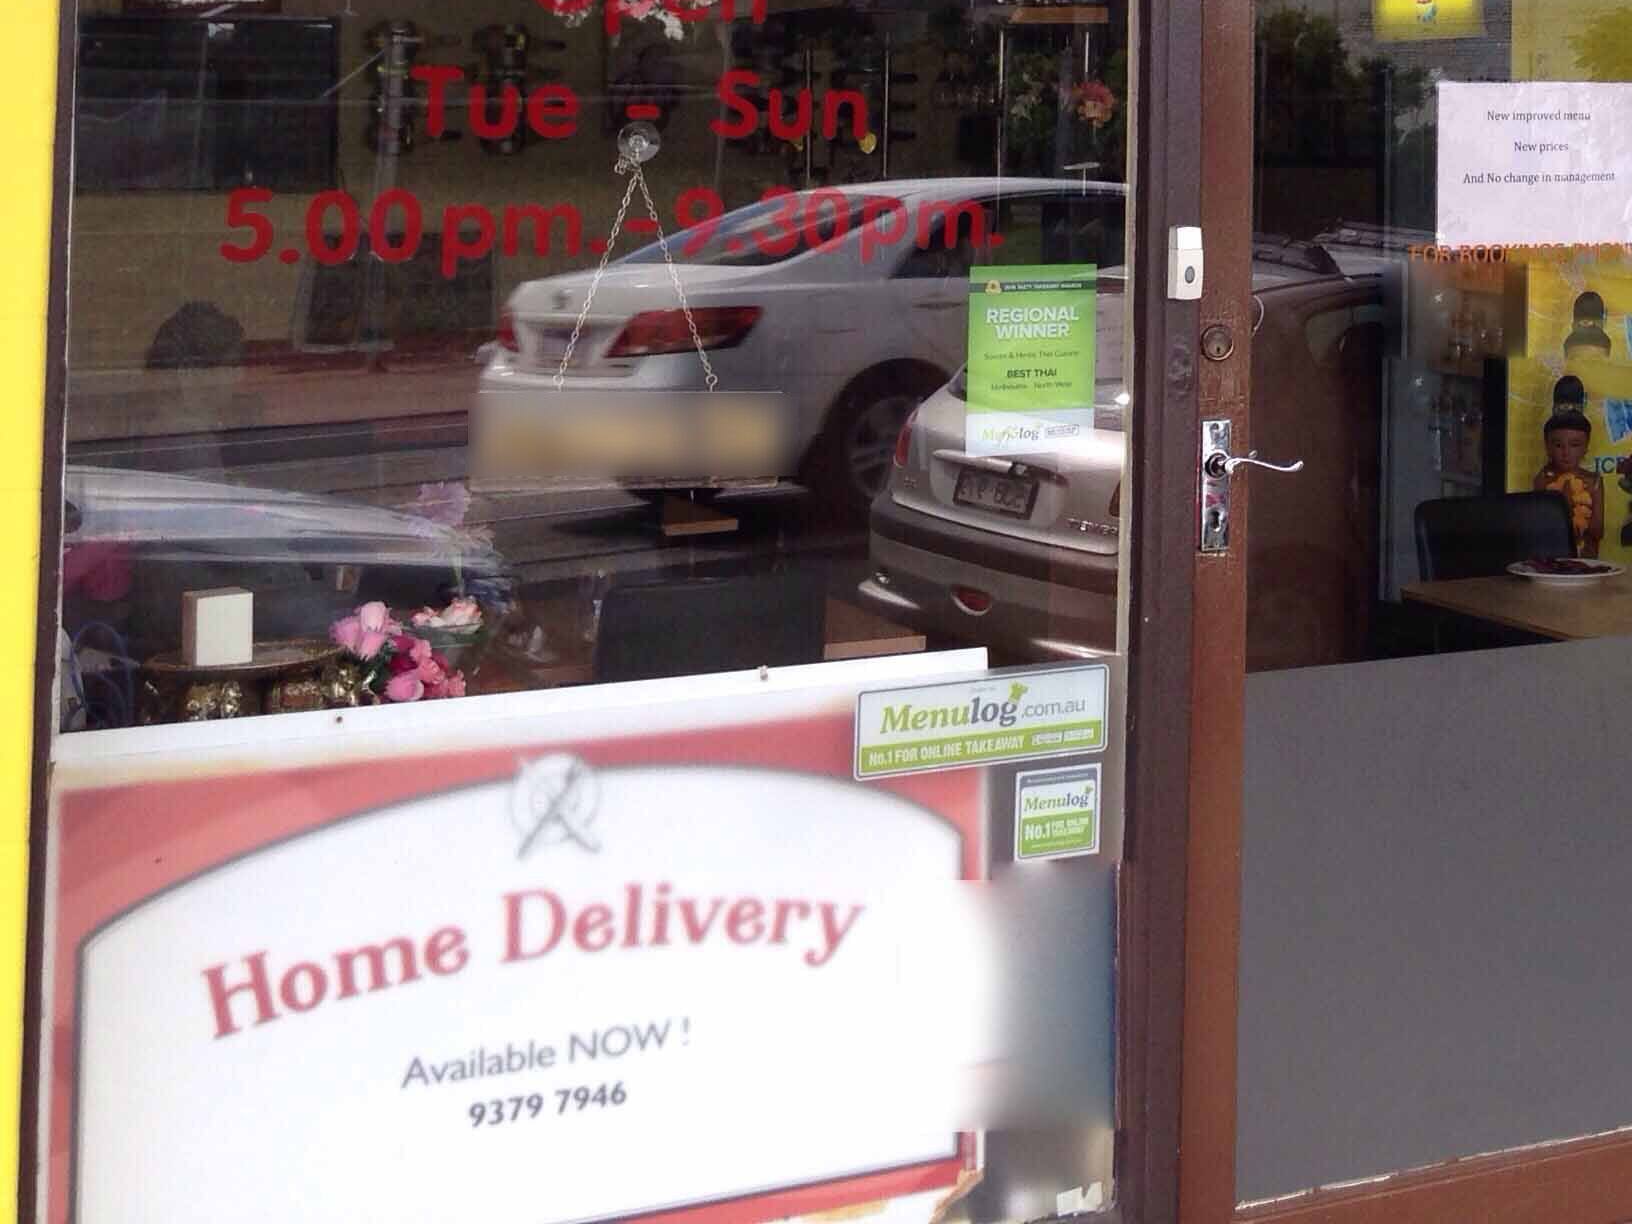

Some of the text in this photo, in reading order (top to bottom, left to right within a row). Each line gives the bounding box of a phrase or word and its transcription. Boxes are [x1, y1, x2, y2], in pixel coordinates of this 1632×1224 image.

[411, 65, 581, 140] Tue
[708, 70, 871, 142] Sun
[1487, 111, 1592, 123] New improved menu
[1514, 142, 1570, 154] New prices
[1463, 172, 1617, 186] And No change in management
[1408, 243, 1450, 264] FOR
[985, 306, 1080, 325] REGIONAL
[995, 324, 1070, 340] WINNER
[1006, 368, 1058, 379] BEST THAI
[869, 752, 893, 767] No.1
[895, 746, 919, 764] FOR
[920, 741, 963, 760] ONLINE
[965, 734, 1025, 755] TAKEAWAY
[1024, 791, 1089, 812] Menulog
[1024, 820, 1051, 841] No.1
[202, 882, 867, 1041] Home Delivery
[400, 1039, 557, 1090] Available
[567, 1018, 673, 1064] NOW
[468, 1080, 629, 1129] 9379 7946
